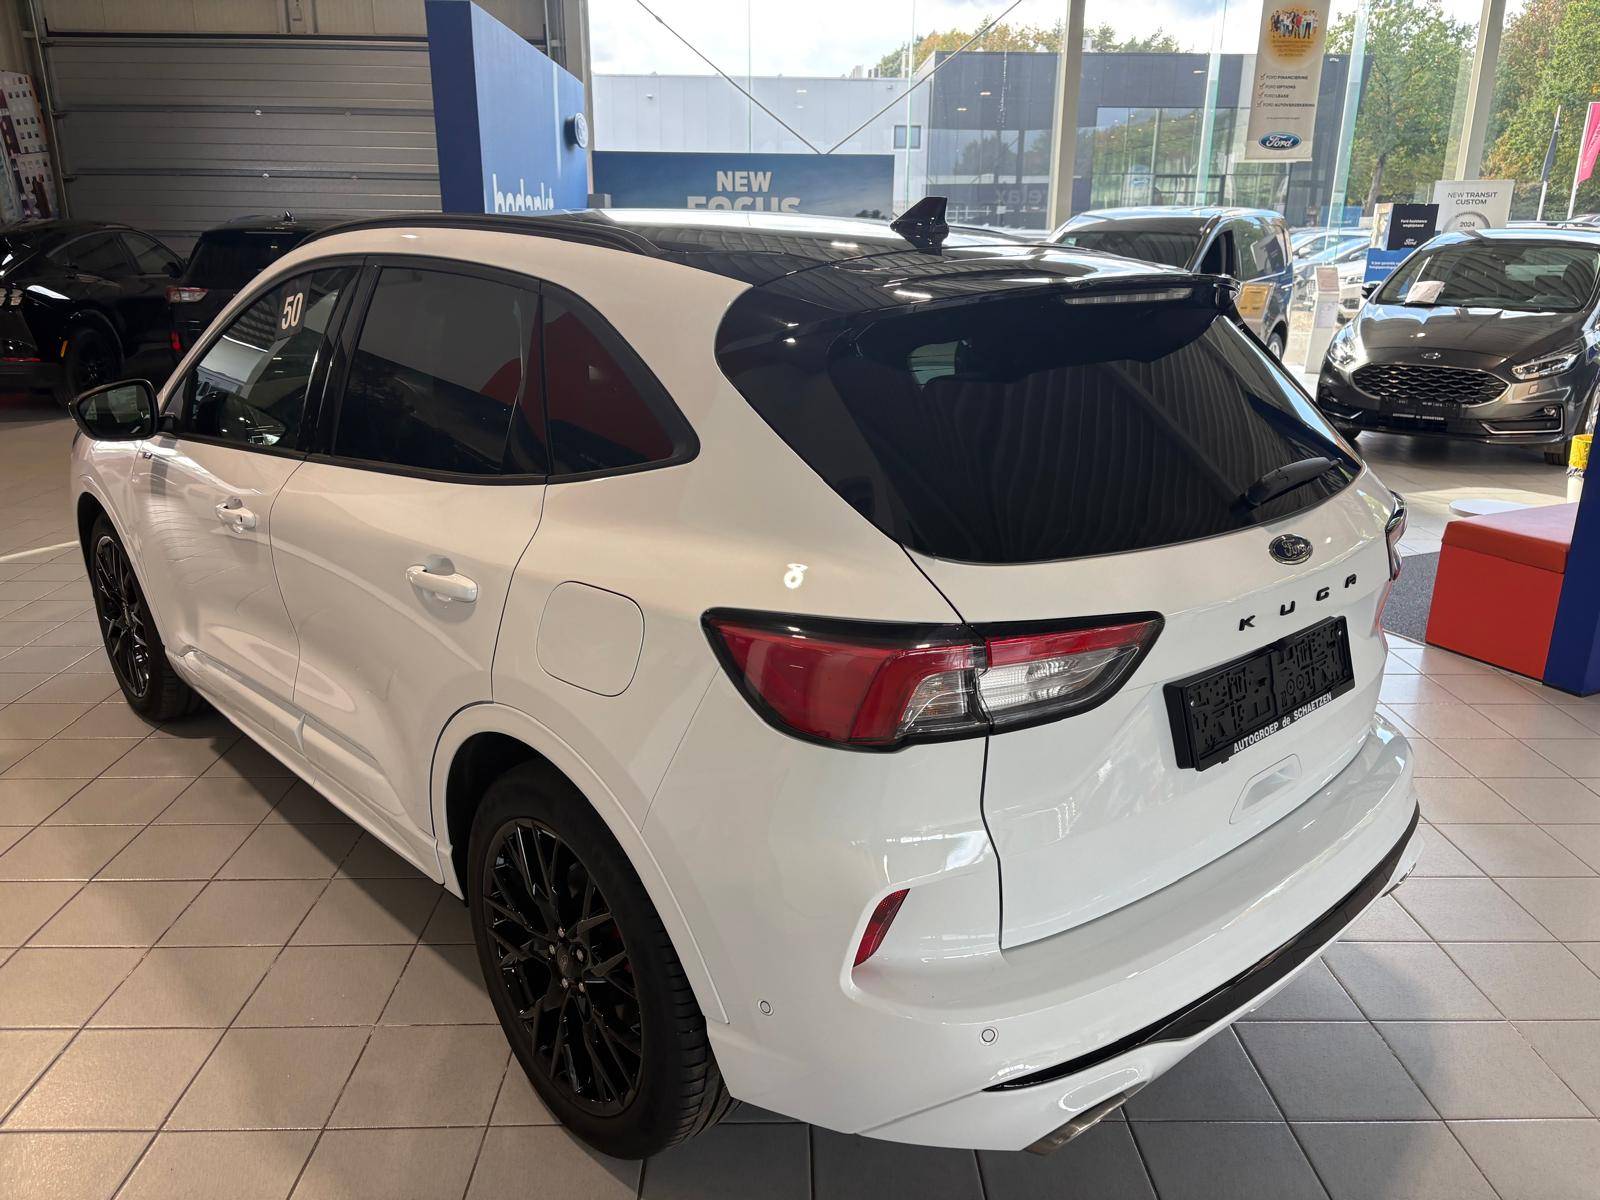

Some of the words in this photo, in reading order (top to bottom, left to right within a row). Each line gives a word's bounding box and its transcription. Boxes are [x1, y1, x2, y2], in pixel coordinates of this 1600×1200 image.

[1266, 135, 1294, 147] Ford
[716, 170, 772, 193] NEW
[281, 292, 304, 330] 50
[1238, 573, 1357, 631] KUGA
[1233, 721, 1279, 753] AUTOGROEP
[1282, 716, 1291, 728] de
[1293, 691, 1332, 720] SCHAETZEN
